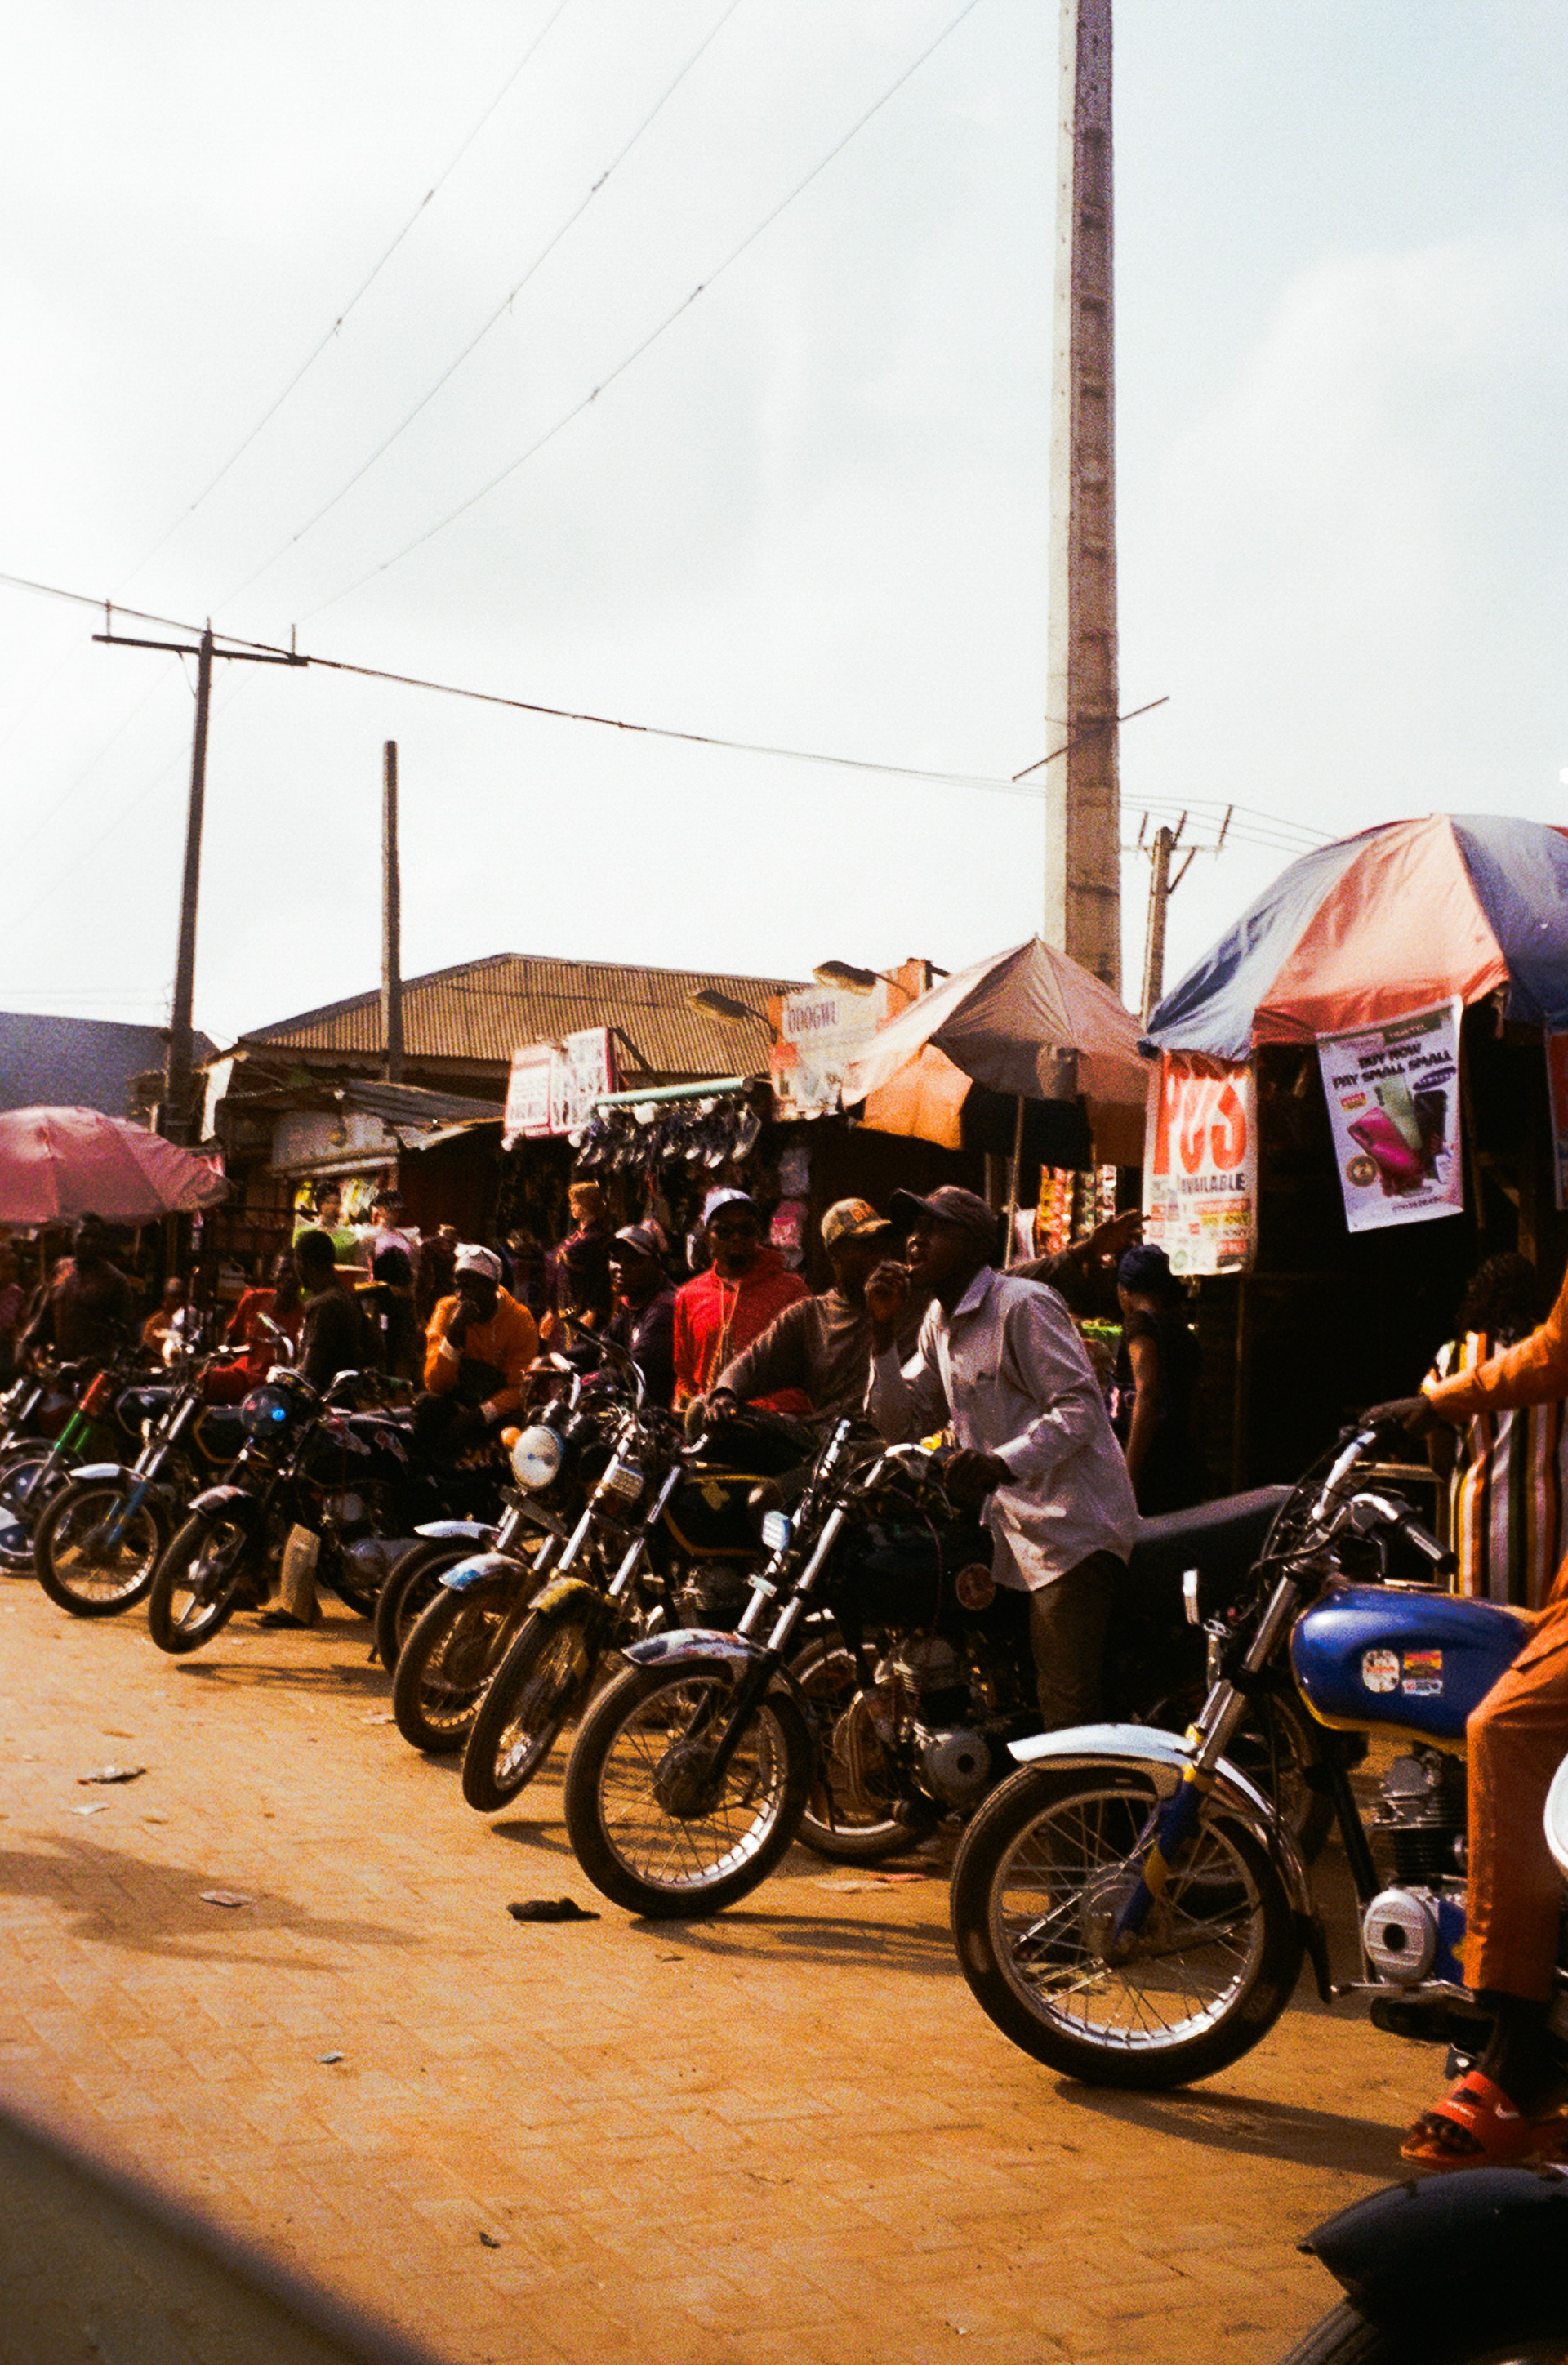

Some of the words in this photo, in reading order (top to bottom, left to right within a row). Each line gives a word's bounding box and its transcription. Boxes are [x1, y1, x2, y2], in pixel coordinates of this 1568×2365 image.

[1358, 1052, 1386, 1069] BUY
[1388, 1042, 1422, 1060] NOW
[1332, 1073, 1358, 1089] PAY
[1361, 1062, 1405, 1082] SMALL
[1408, 1050, 1453, 1071] SMALL
[1180, 1173, 1245, 1195] AVAILABLE
